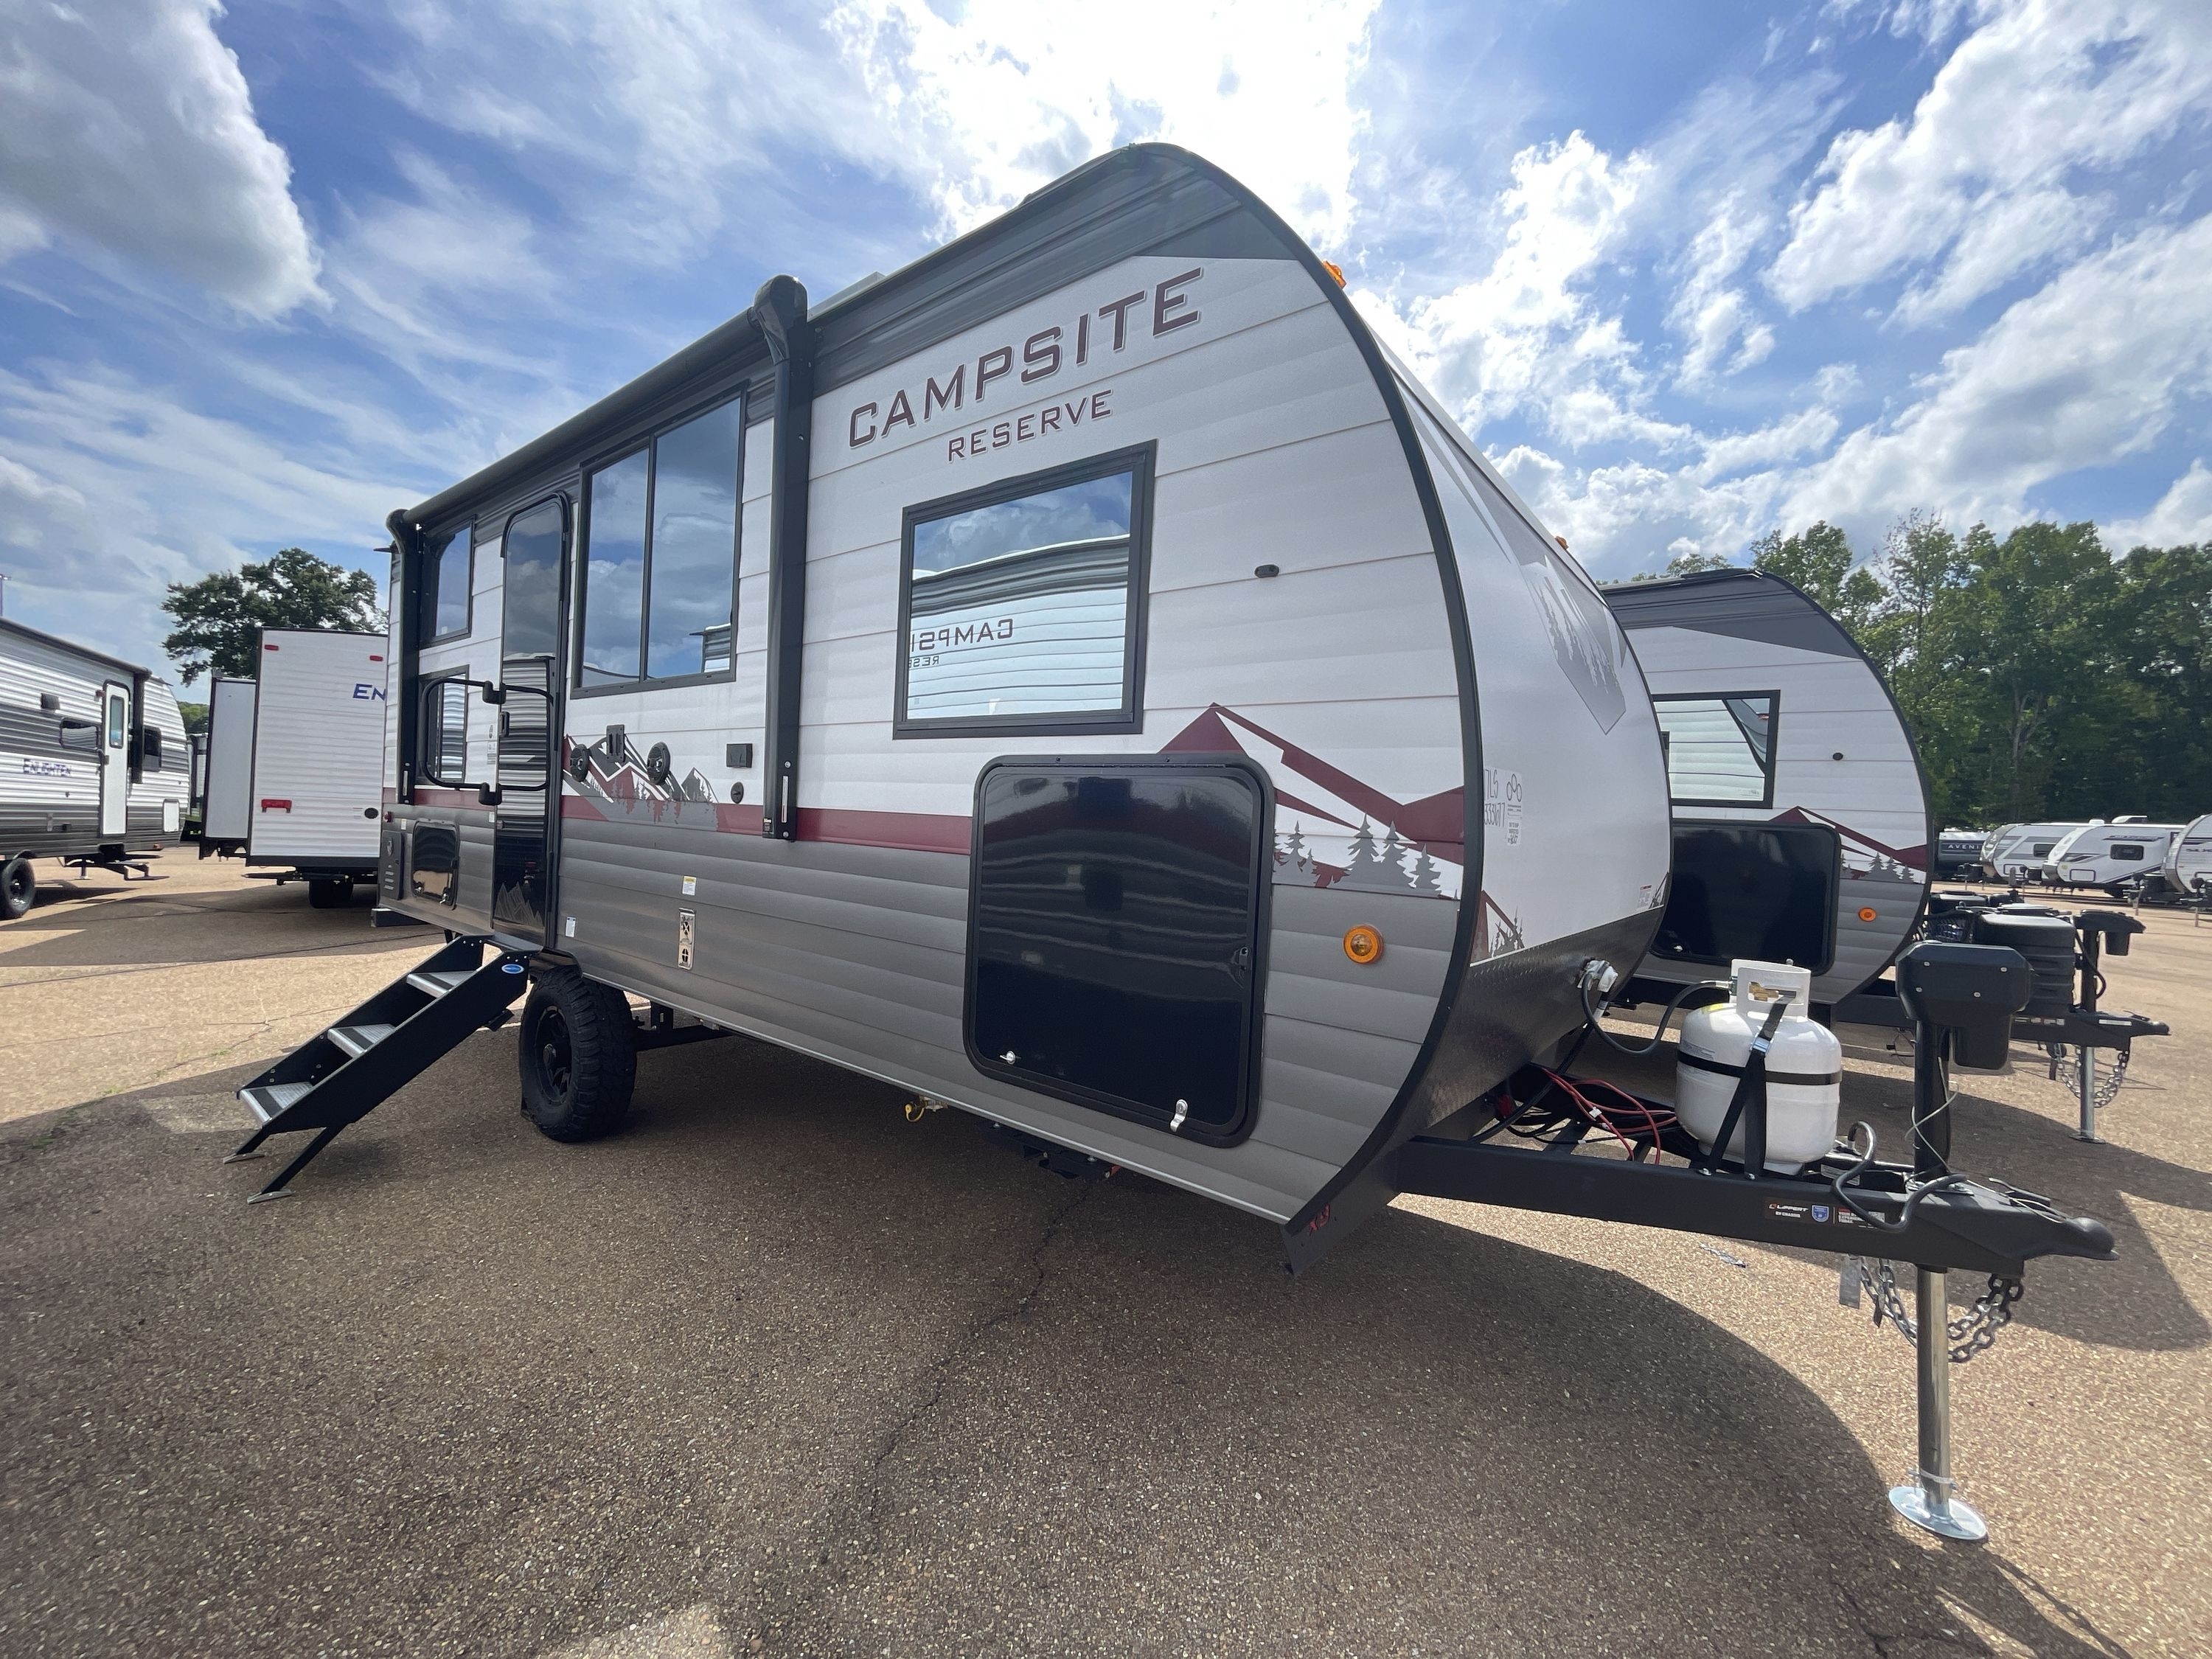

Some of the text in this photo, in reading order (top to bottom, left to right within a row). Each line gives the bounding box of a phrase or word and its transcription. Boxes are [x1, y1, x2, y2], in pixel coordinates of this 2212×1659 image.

[849, 267, 1203, 448] CAMPSITE
[948, 389, 1113, 462] RESERVE
[352, 684, 386, 701] EN
